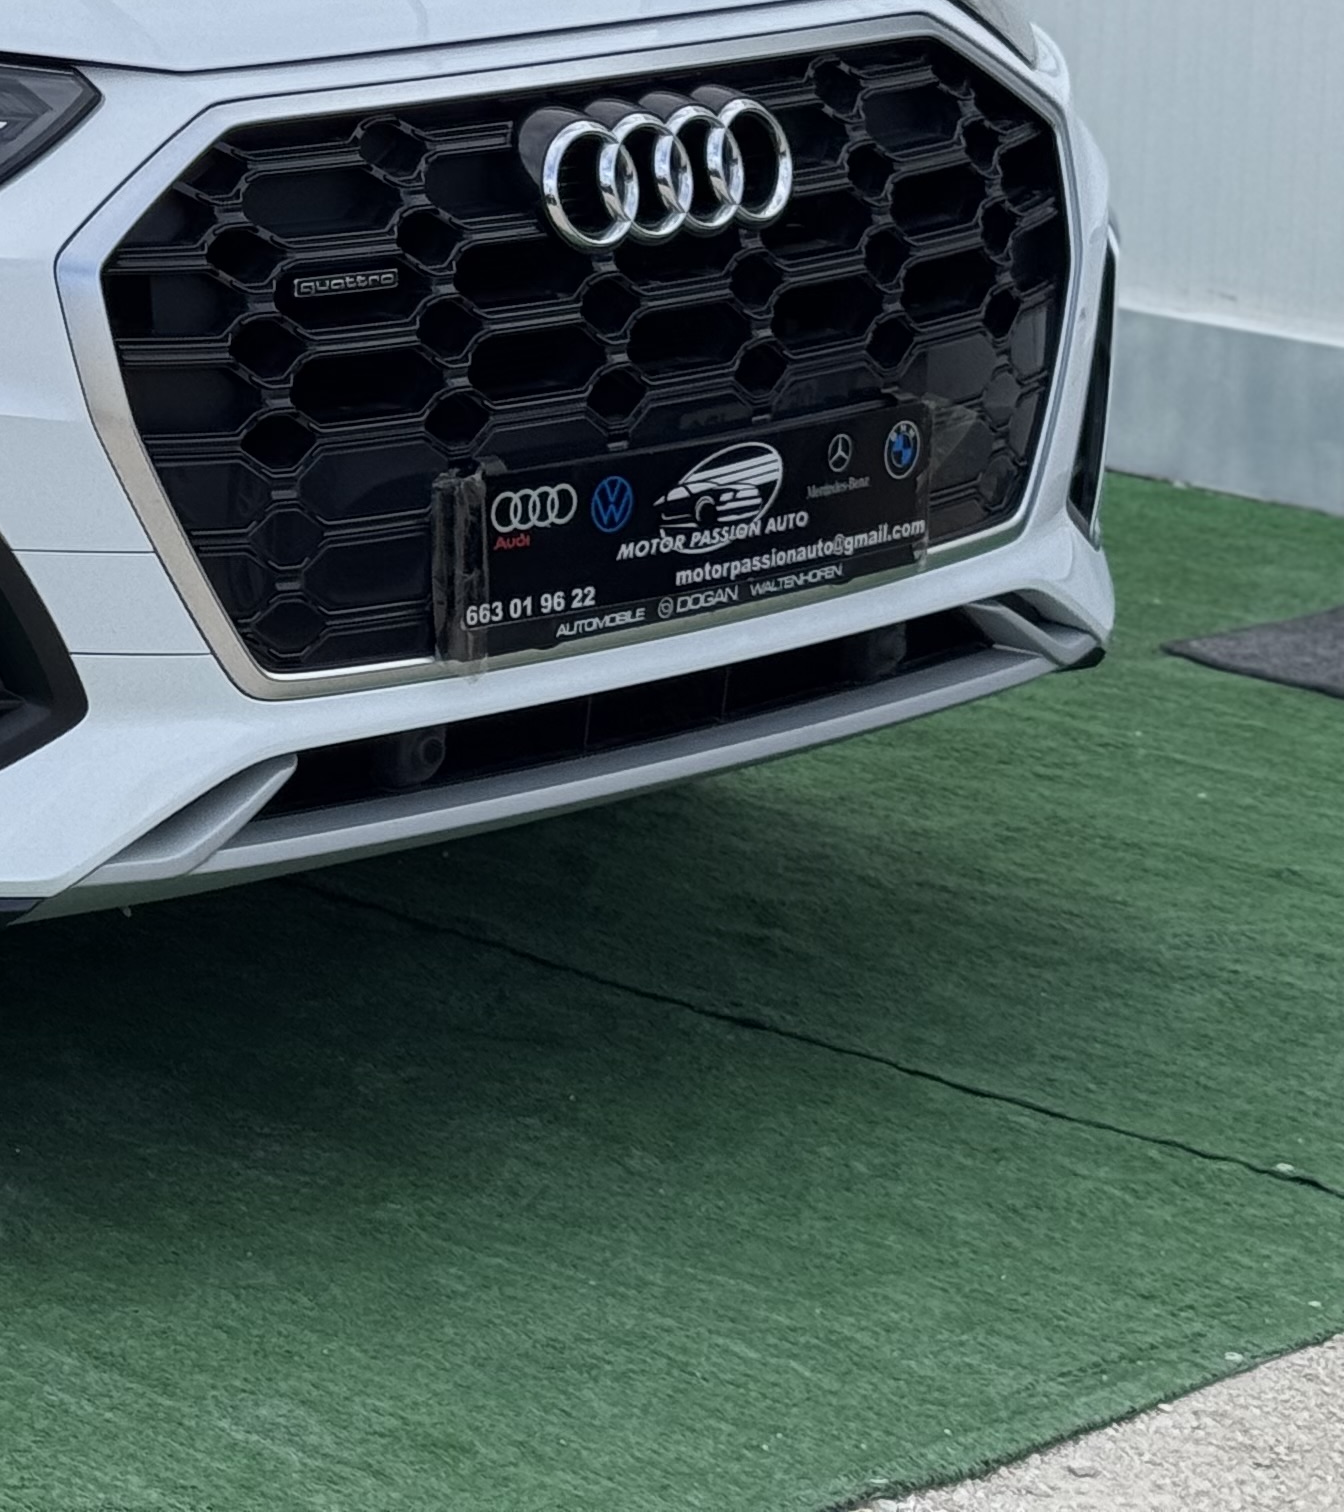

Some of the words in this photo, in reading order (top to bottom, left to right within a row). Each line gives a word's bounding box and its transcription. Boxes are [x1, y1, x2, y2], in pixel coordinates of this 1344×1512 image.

[300, 272, 394, 296] quattro
[493, 532, 531, 551] Audi
[615, 533, 685, 562] MOTOR
[689, 520, 762, 548] PASSION
[765, 511, 809, 535] AUTO
[675, 519, 926, 586] motorpassionauto@gmail.com
[465, 601, 504, 626] 663
[509, 595, 533, 619] 01
[540, 591, 566, 614] 96
[571, 585, 596, 609] 22
